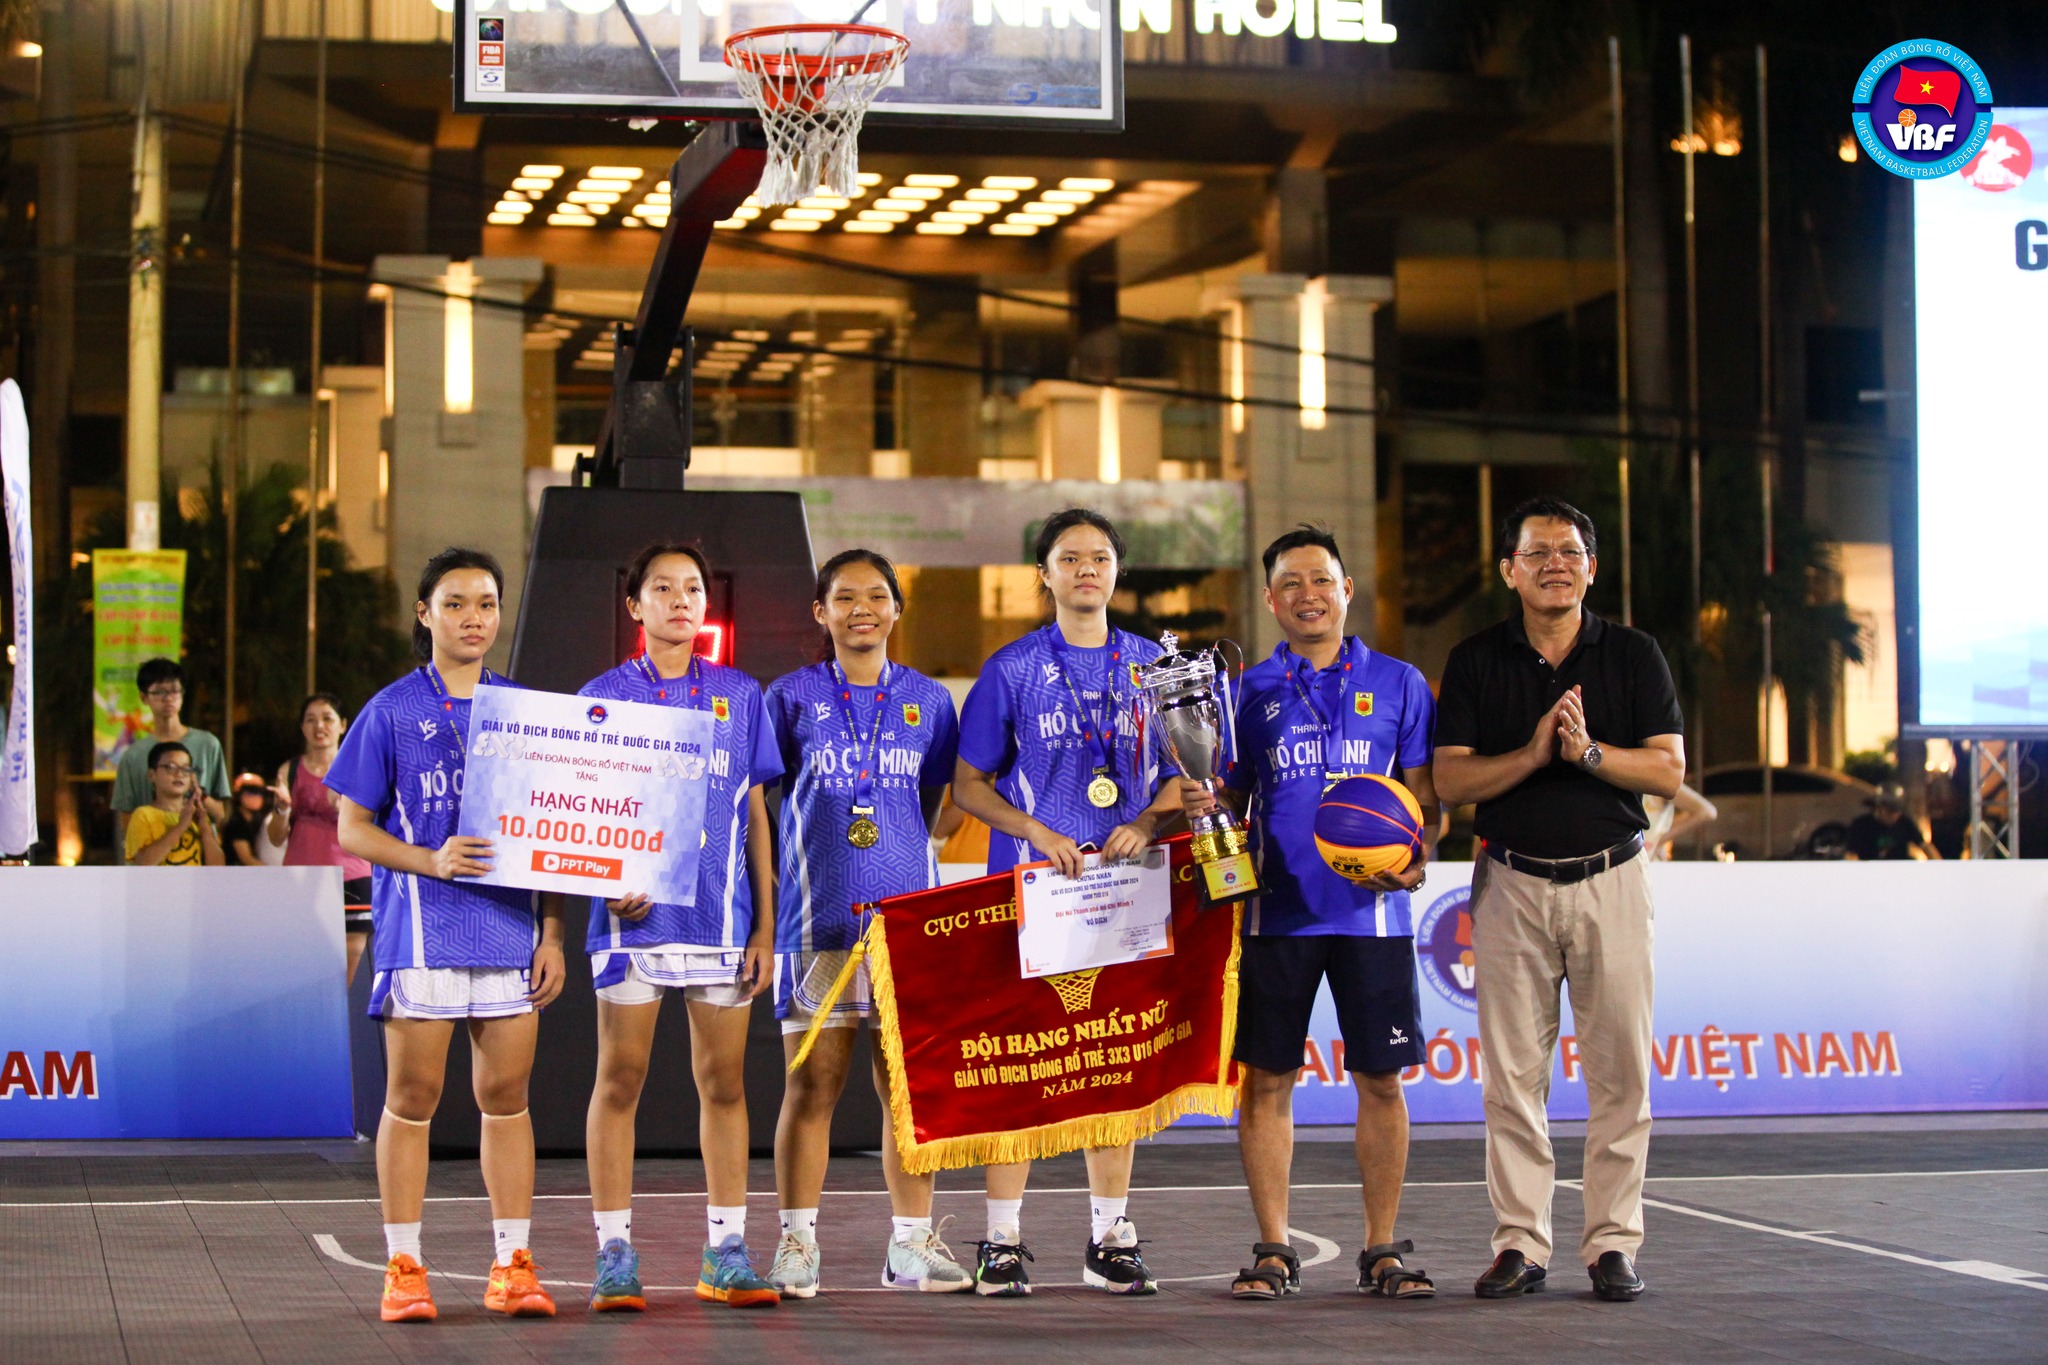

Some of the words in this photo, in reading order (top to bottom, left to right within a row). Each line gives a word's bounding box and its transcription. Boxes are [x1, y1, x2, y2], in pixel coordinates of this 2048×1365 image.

[482, 718, 503, 732] GIẢI
[507, 721, 520, 734] VÔ
[524, 725, 548, 738] ĐỊCH
[552, 726, 580, 740] BÓNG
[584, 728, 598, 742] RỔ
[602, 731, 620, 745] TRẺ
[623, 735, 650, 748] QUỐC
[654, 740, 670, 750] GIA
[674, 742, 700, 754] 2024
[1038, 702, 1066, 738] HỒ
[525, 752, 543, 760] LIÊN
[545, 754, 570, 764] ĐOÀN
[572, 757, 596, 768] BÓNG
[613, 761, 630, 772] VIỆT
[632, 764, 652, 774] NAM
[812, 740, 836, 776] HỒ
[879, 748, 922, 778] MINH
[1266, 736, 1290, 770] HỒ
[1294, 734, 1322, 764] CHÍ
[531, 790, 586, 812] HẠNG
[592, 796, 643, 818] NHẤT
[498, 815, 664, 853] 10.000.000đ
[562, 858, 584, 872] FPT
[586, 860, 610, 876] Play
[924, 912, 970, 936] CỤC
[1424, 960, 1452, 998] VIETNAM
[960, 1032, 1002, 1061] ĐỘI
[1006, 1027, 1070, 1058] HẠNG
[1074, 1008, 1136, 1042] NHẤT
[1141, 1000, 1169, 1030] NỮ
[954, 1063, 980, 1088] GIẢI
[982, 1064, 998, 1086] VÔ
[1000, 1064, 1028, 1086] ĐỊCH
[1030, 1057, 1062, 1082] BÓNG
[1065, 1047, 1082, 1076] RỔ
[1083, 1042, 1106, 1070] TRẺ
[1108, 1046, 1130, 1066] 3X3
[1133, 1042, 1152, 1062] U16
[1153, 1028, 1175, 1055] QUỐC
[1176, 1020, 1193, 1041] GIA
[1652, 1024, 1762, 1092] VIỆT
[1774, 1031, 1902, 1078] NAM
[0, 1051, 99, 1100] AM
[1042, 1076, 1086, 1099] NĂM
[1090, 1070, 1134, 1088] 2024
